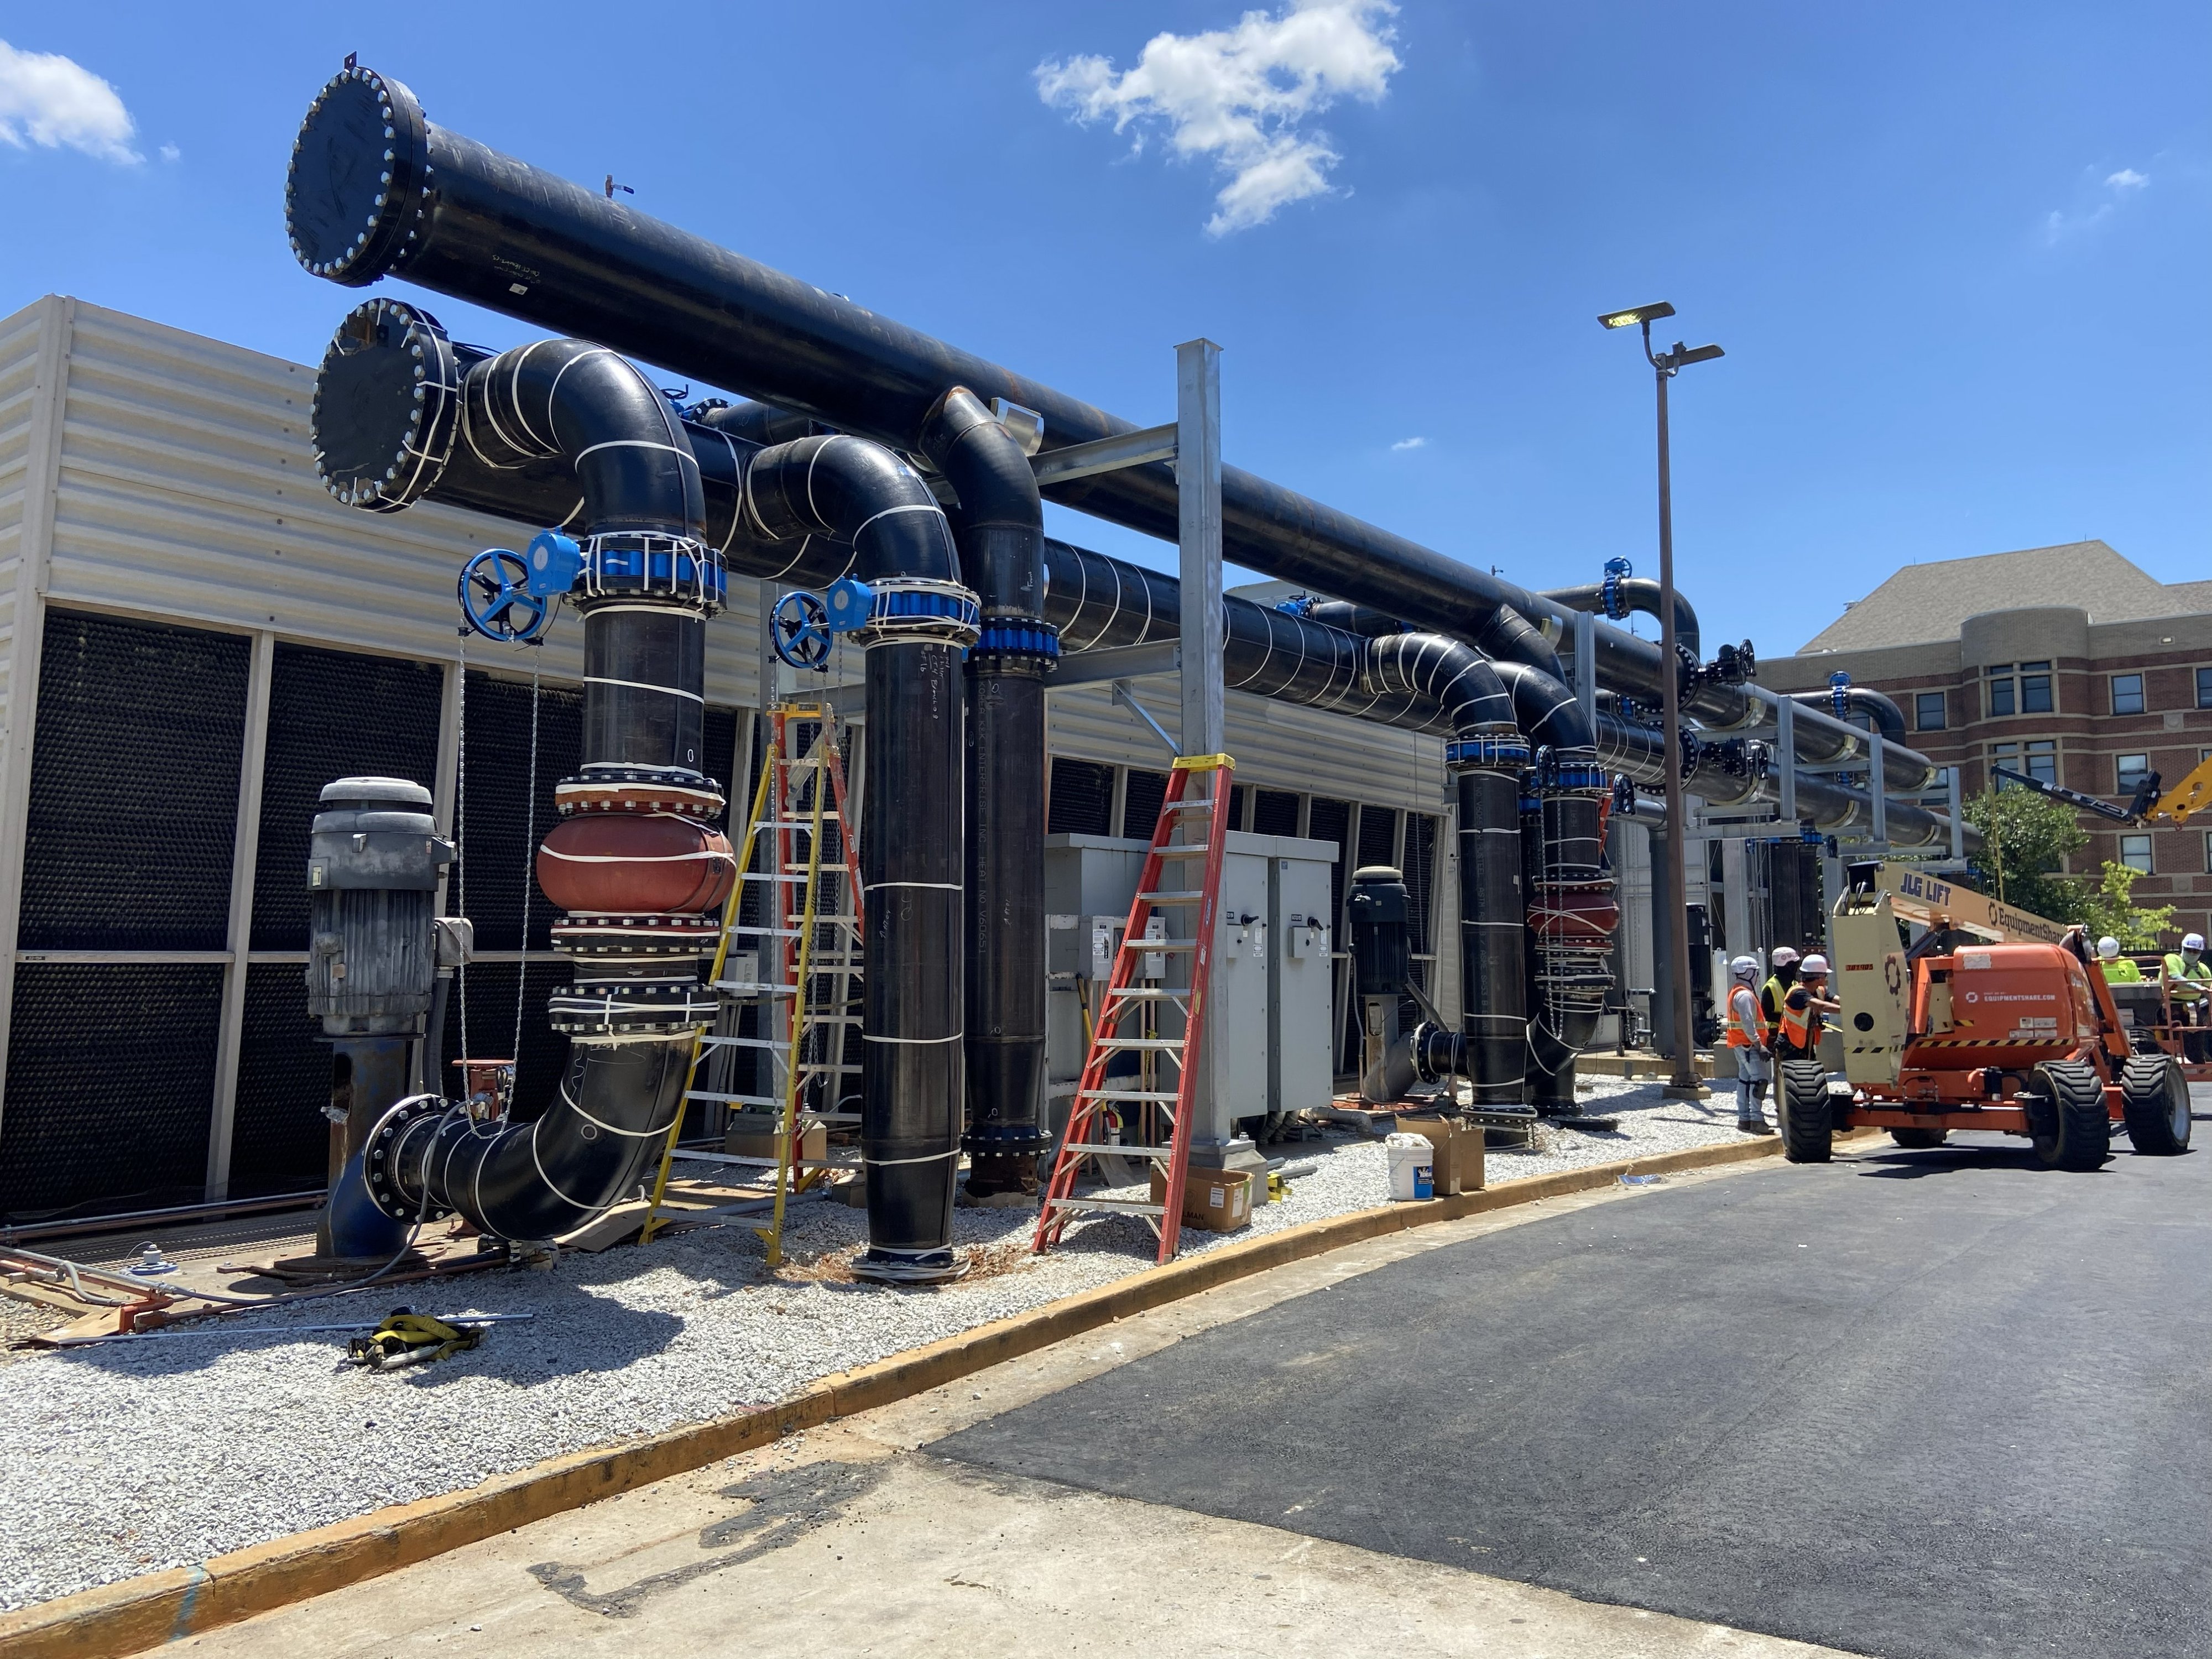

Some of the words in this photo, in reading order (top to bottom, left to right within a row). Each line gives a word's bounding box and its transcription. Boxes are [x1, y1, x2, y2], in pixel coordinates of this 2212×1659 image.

[978, 747, 987, 814] ENTERPRISE
[978, 856, 987, 882] HEAT
[979, 890, 987, 904] NO
[1900, 873, 1923, 898] JLG
[1926, 879, 1951, 906] LIFT
[1182, 1211, 1204, 1220] LMAN
